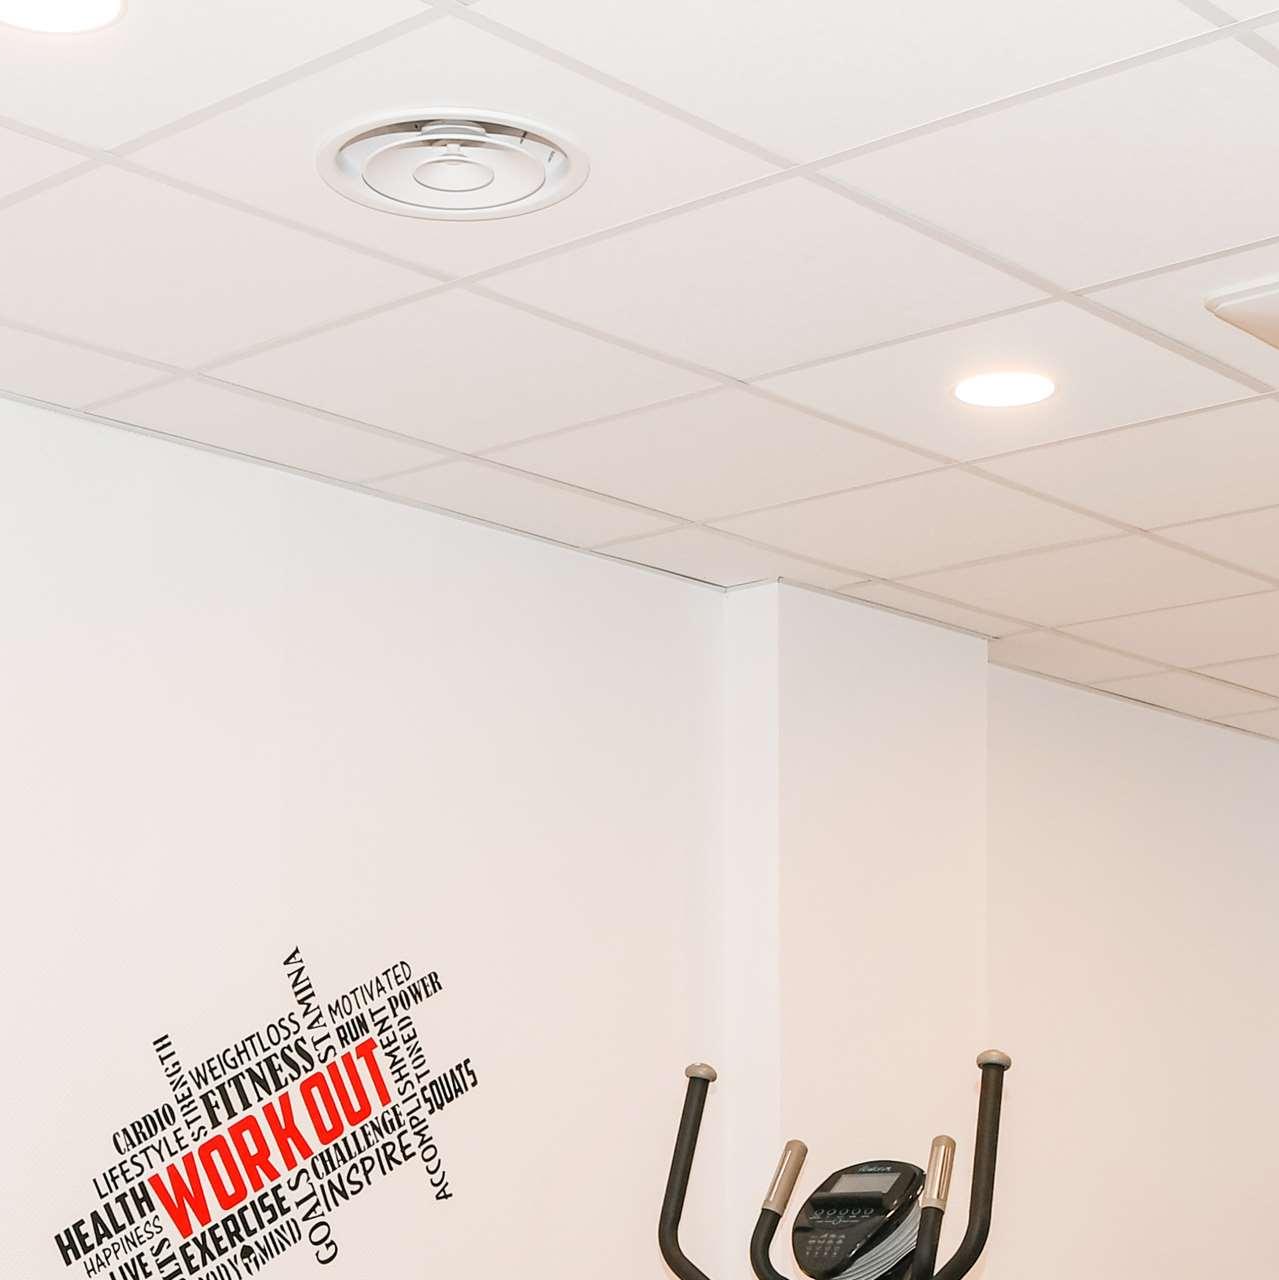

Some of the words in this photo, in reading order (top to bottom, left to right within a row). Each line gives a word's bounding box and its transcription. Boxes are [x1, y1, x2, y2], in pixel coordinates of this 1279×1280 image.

[283, 947, 337, 1063] STAMINA
[328, 961, 411, 1024] MOTIVATED
[336, 1013, 369, 1048] RUN
[387, 972, 442, 1018] POWER
[153, 1034, 207, 1142] STRENGTH
[188, 1012, 300, 1090] WEIGHTLOSS
[199, 1036, 314, 1130] FITNESS
[397, 1016, 430, 1083] TONED
[420, 1058, 477, 1115] SQUATS
[113, 1104, 176, 1155] CARDIO
[148, 1091, 314, 1239] WORK
[300, 1037, 391, 1145] OUT
[368, 1006, 452, 1200] ACCOMPLISHMENT
[93, 1127, 189, 1199] LIFESTYLE
[311, 1104, 405, 1180] CHALLENGE
[320, 1129, 416, 1212] INSPIRE
[54, 1181, 155, 1266] HEALTH
[83, 1215, 163, 1278] HAPPINESS
[179, 1184, 291, 1275] EXERCISE
[254, 1218, 301, 1265] MIND
[287, 1168, 338, 1264] GOALS
